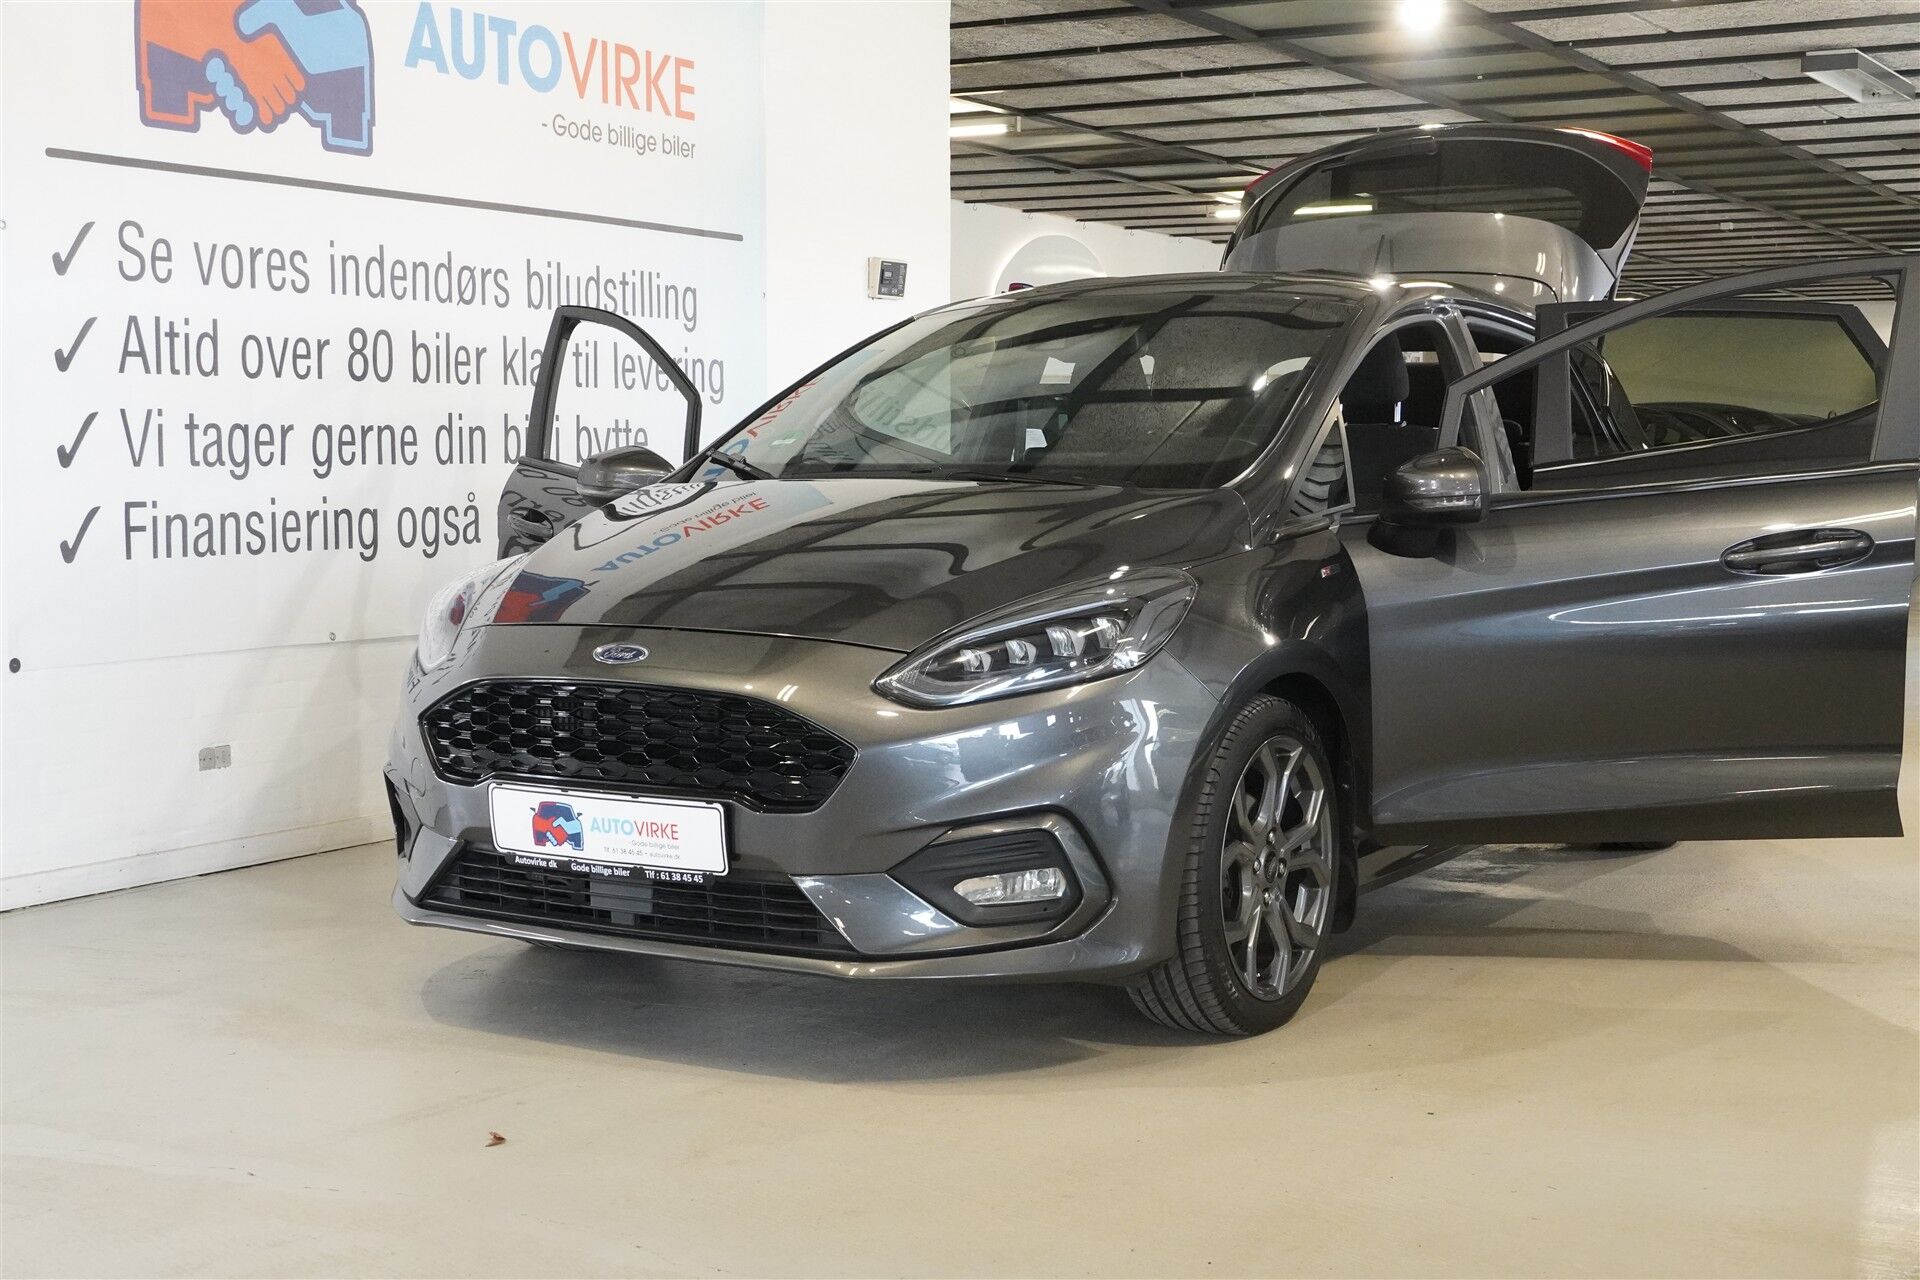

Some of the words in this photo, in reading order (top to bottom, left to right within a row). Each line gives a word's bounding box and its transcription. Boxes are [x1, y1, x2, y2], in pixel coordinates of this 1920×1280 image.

[404, 1, 696, 121] AUTOVIRKE
[552, 113, 602, 143] Gode
[607, 123, 657, 156] billige
[662, 133, 696, 159] biler
[118, 220, 173, 284] Se
[193, 241, 310, 294] vores
[329, 240, 510, 309] indendørs
[526, 258, 697, 333] biludstilling
[118, 315, 219, 377] Altid
[241, 334, 330, 380] over
[347, 327, 394, 383] 80
[411, 329, 487, 386] biler
[502, 335, 543, 386] kla
[572, 340, 598, 388] til
[119, 408, 164, 467] Vi
[184, 413, 294, 480] tager
[312, 423, 418, 479] gerne
[435, 412, 486, 466] din
[124, 496, 379, 562] Finansiering
[397, 491, 481, 558] også
[590, 817, 679, 840] AUTOVIRKE
[515, 855, 547, 867] Autovirke
[571, 862, 590, 873] Gode
[591, 864, 613, 876] billige
[613, 867, 630, 877] biler
[644, 870, 655, 879] Tlf
[660, 871, 670, 880] 61
[671, 872, 681, 882] 38
[682, 873, 692, 882] 45
[693, 874, 704, 883] 45
